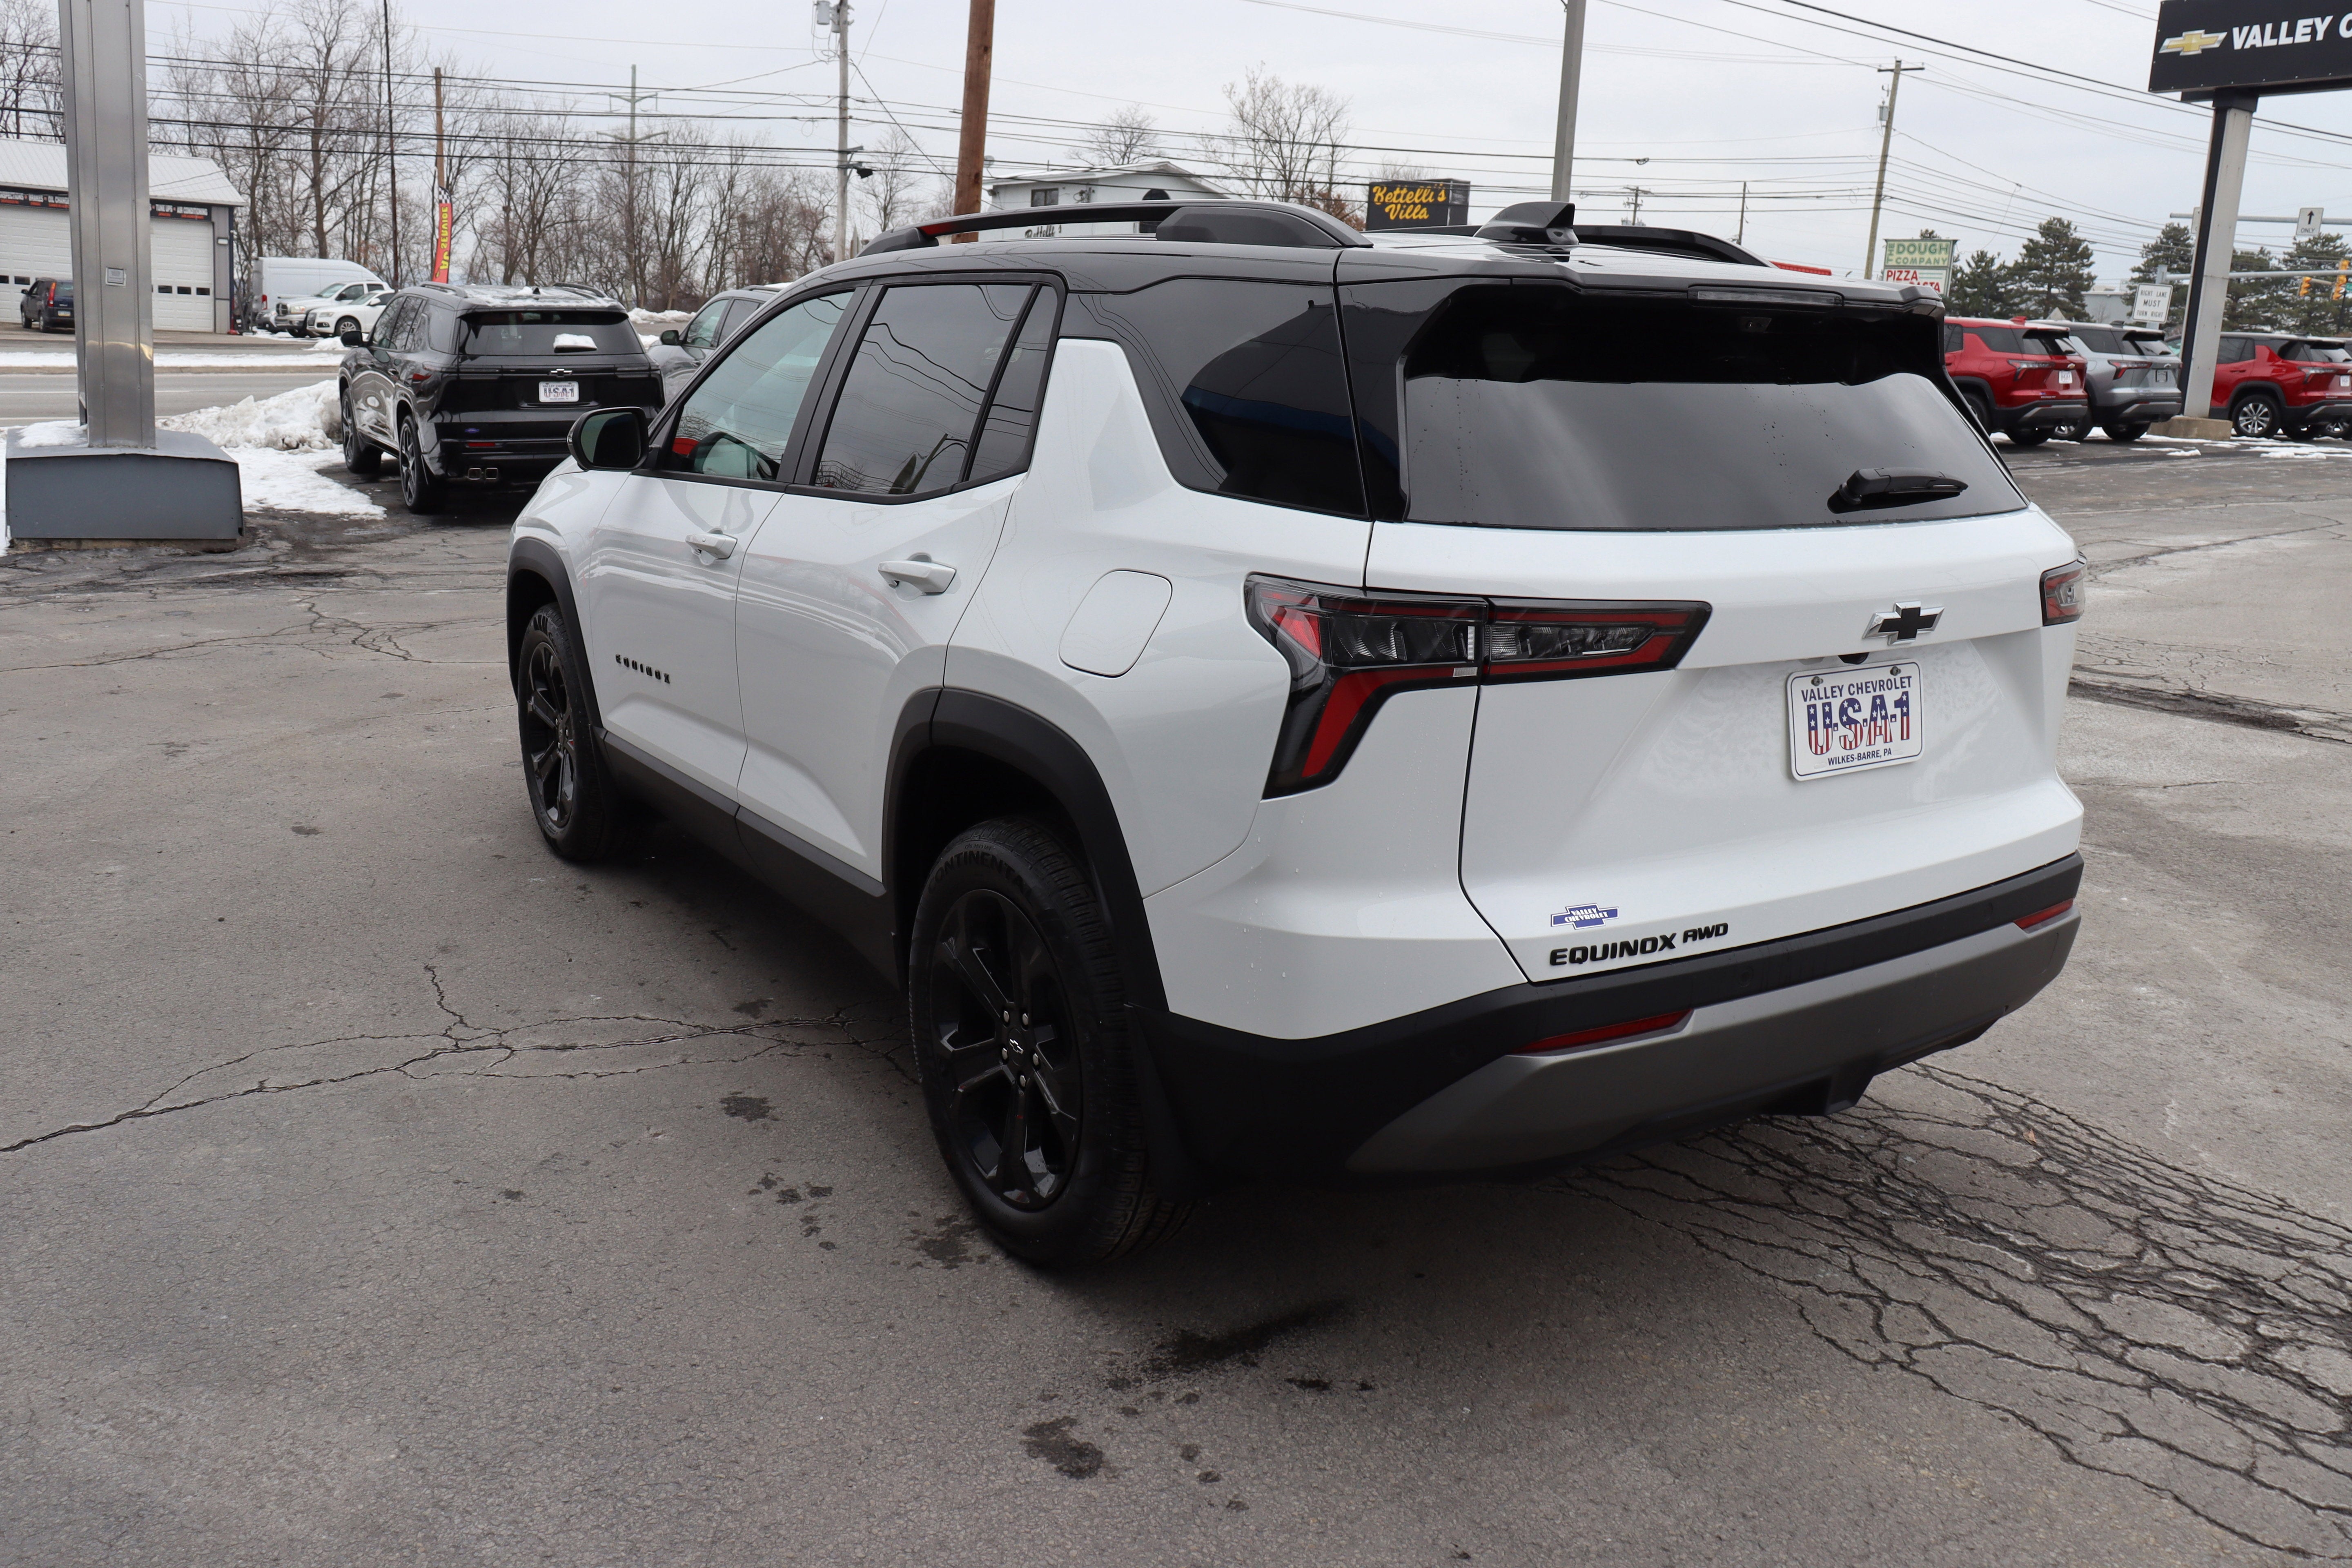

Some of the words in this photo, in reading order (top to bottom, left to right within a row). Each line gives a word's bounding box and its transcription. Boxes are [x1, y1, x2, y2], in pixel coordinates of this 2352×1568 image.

[2232, 15, 2334, 50] VALLEY
[1385, 203, 1430, 220] Villa
[1886, 243, 1895, 264] THE
[1896, 243, 1949, 255] DOUGH
[1886, 270, 1918, 281] PIZZA
[2143, 299, 2161, 307] MUST
[615, 654, 670, 684] EQUINOX
[1801, 684, 1844, 702] VALLEY
[1848, 676, 1912, 696] CHEVROLET
[1828, 750, 1882, 766] WILKES-BARRE,
[1884, 748, 1892, 757] PA
[1564, 912, 1608, 922] CHEVROLET
[1571, 908, 1597, 916] VALLEY
[1550, 932, 1677, 966] EQUINOX
[1683, 923, 1728, 943] AWD
